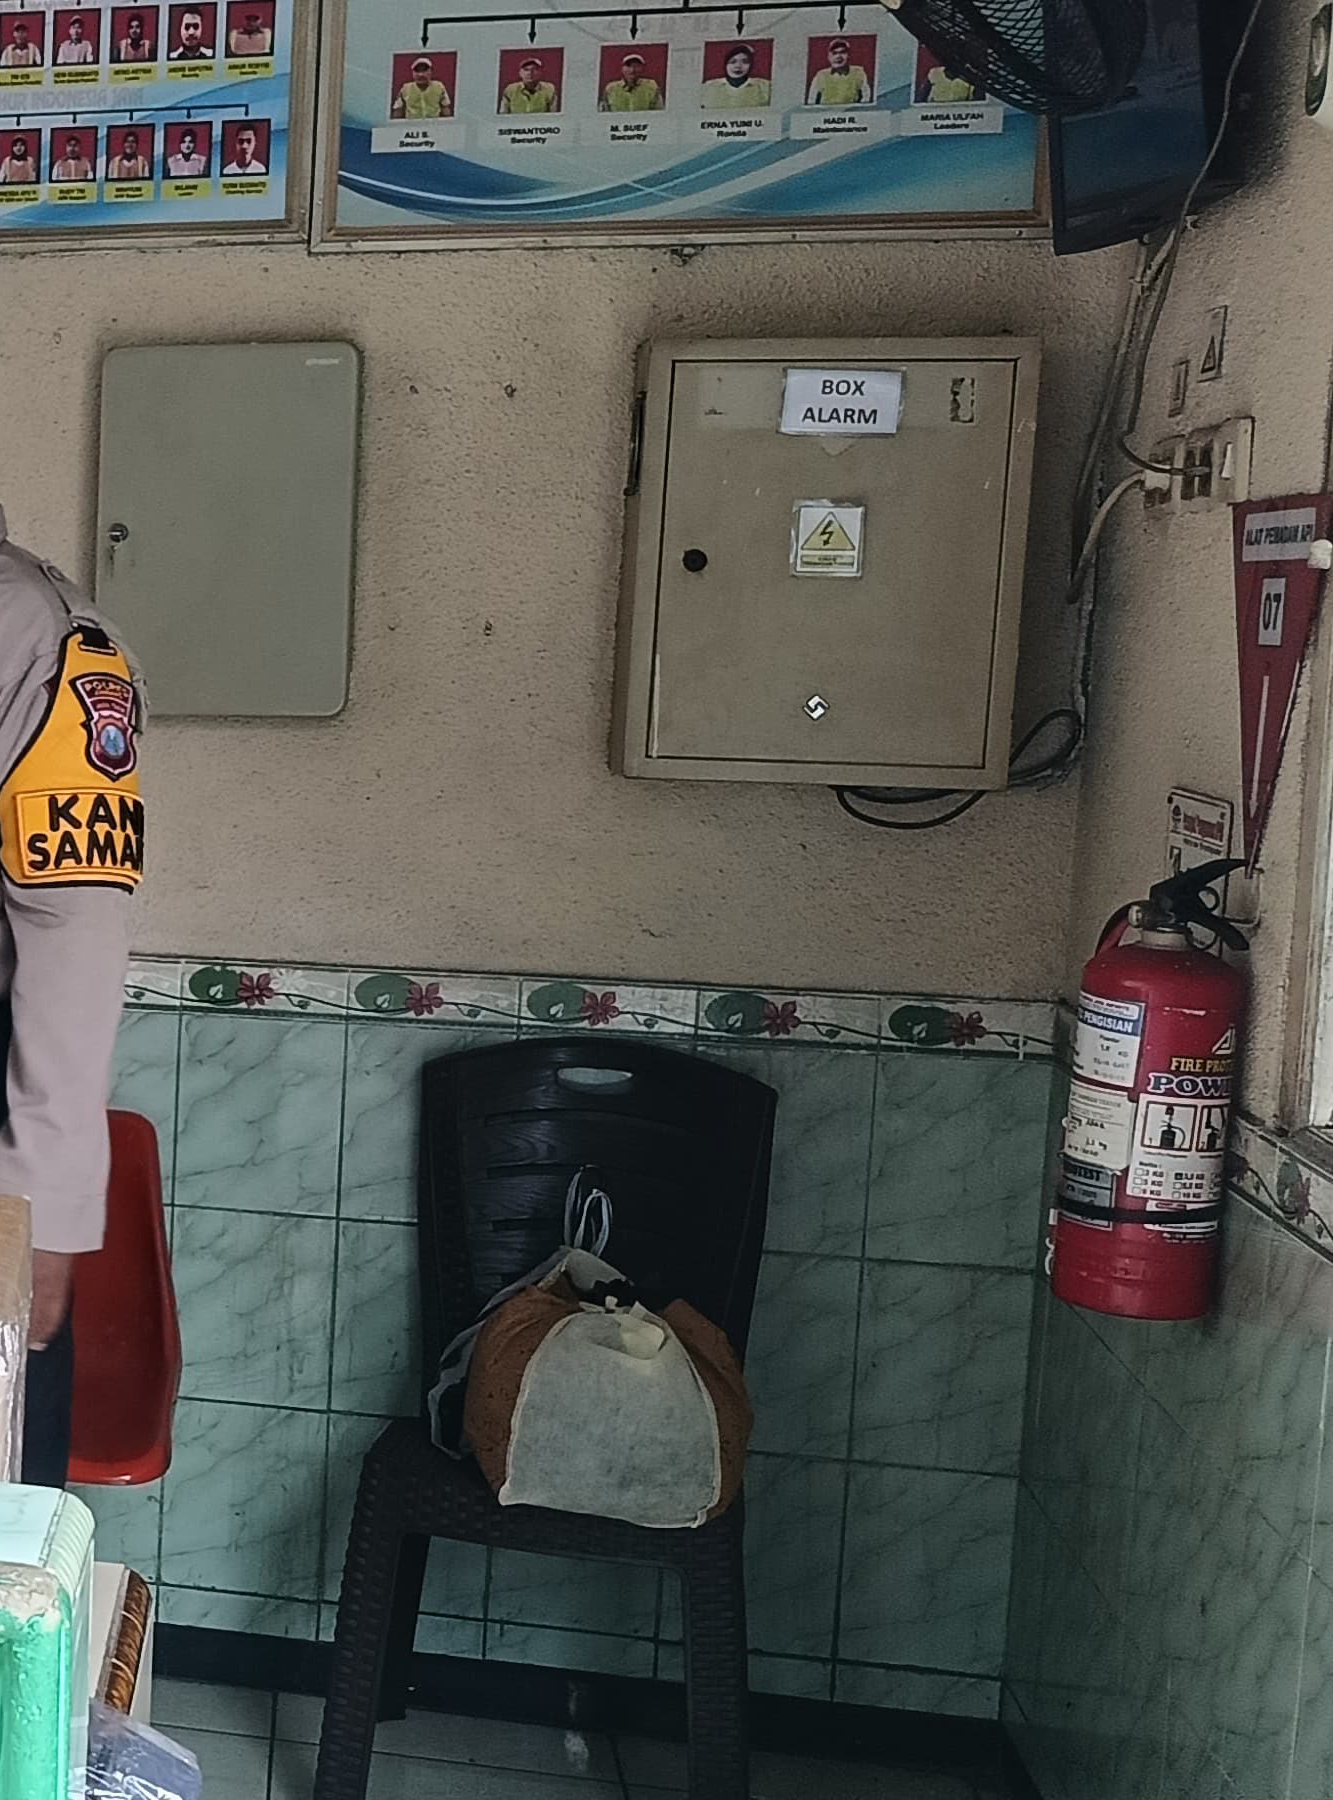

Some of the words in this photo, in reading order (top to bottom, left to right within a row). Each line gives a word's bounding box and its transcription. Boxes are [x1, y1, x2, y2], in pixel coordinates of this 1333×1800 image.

[823, 117, 846, 125] HADI
[921, 113, 951, 122] MARIA
[952, 112, 984, 121] ULFAH
[700, 121, 728, 130] ERNA
[404, 131, 419, 139] ALI
[498, 126, 561, 136] SISWANTORO
[510, 136, 547, 145] Security
[610, 133, 647, 142] Security
[399, 140, 435, 148] Security
[821, 379, 866, 396] BOX
[801, 407, 878, 425] ALARM
[1245, 527, 1264, 546] ALAT
[1263, 592, 1282, 631] 07
[48, 793, 144, 834] KAN
[1084, 1010, 1133, 1033] PENGISIAN
[1170, 1057, 1203, 1072] FIRE
